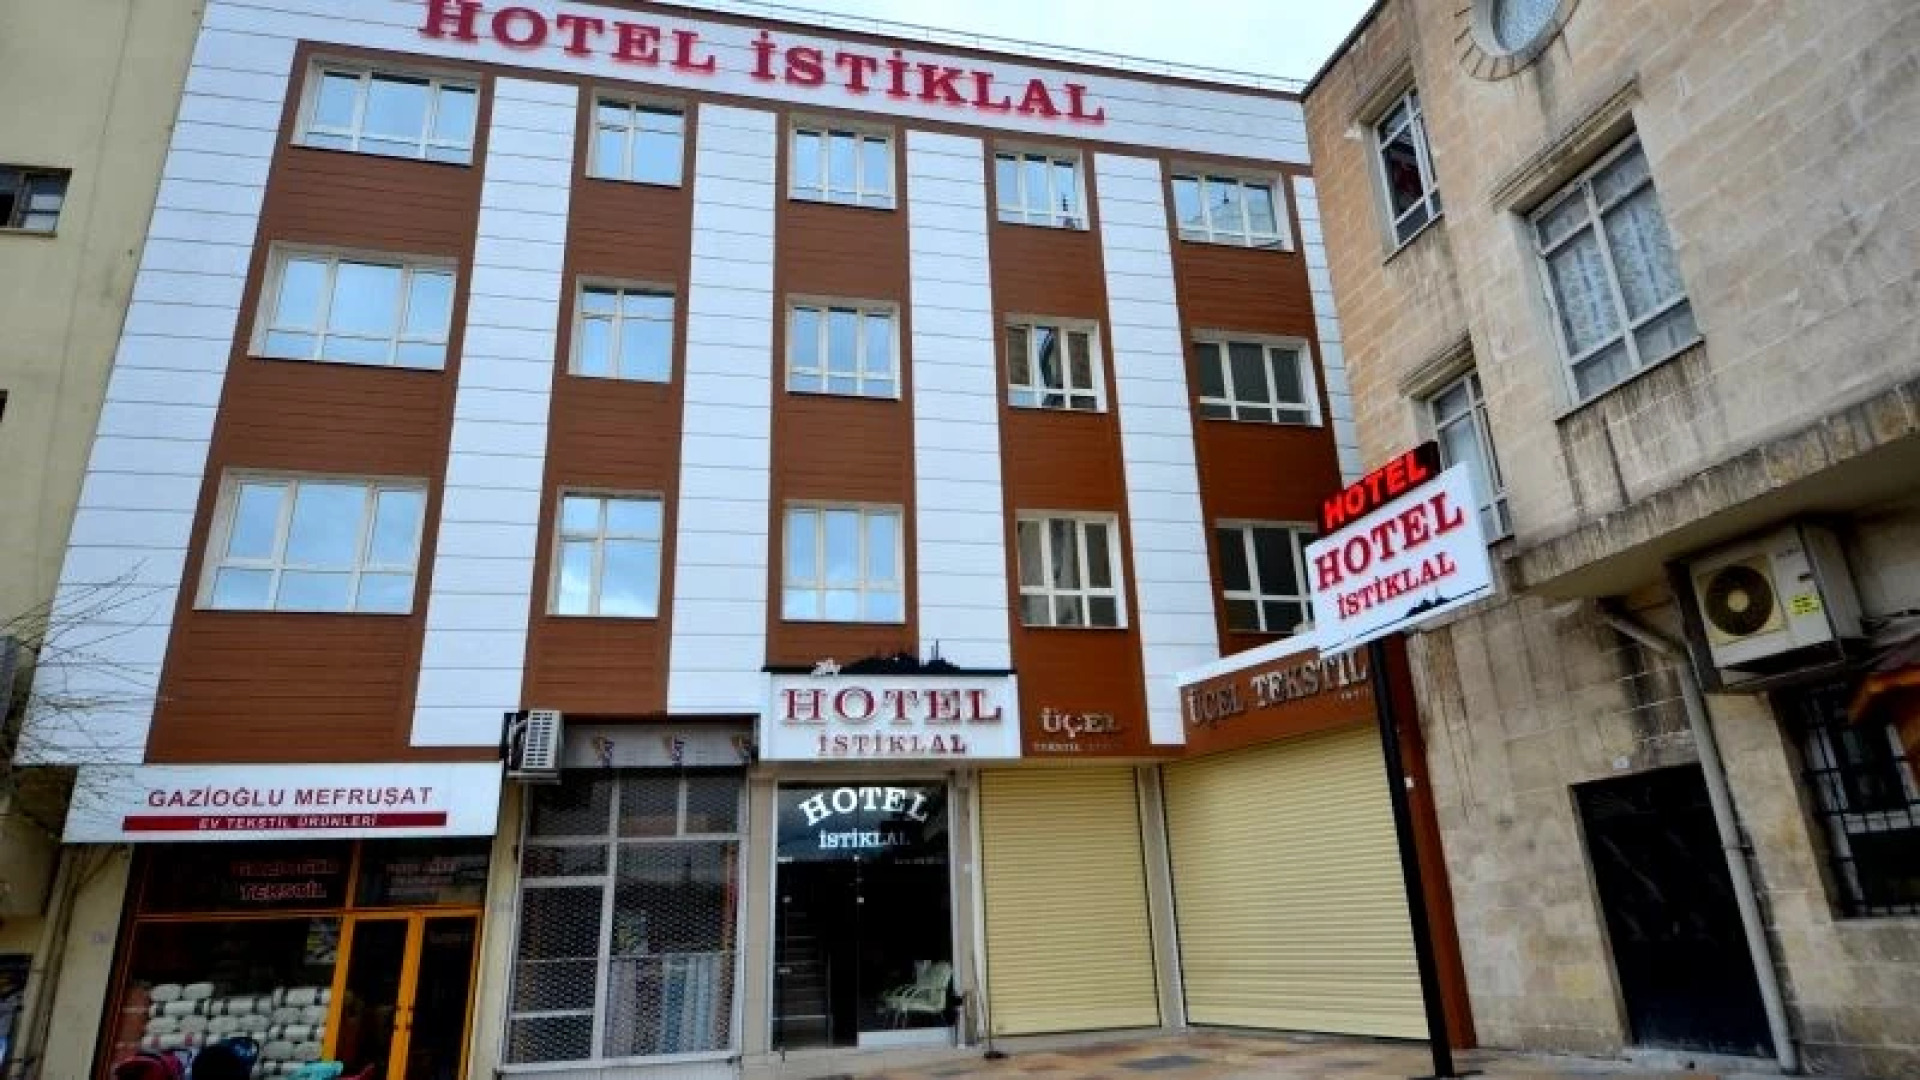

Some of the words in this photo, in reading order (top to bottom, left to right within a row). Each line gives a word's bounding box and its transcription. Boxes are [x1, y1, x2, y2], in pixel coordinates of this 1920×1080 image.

[418, 0, 716, 73] HOTEL
[750, 30, 1105, 125] İSTİKLAL
[1323, 450, 1428, 529] HOTEL
[1313, 491, 1465, 591] HOTEL
[1336, 551, 1457, 620] İSTİKLAL
[781, 686, 1003, 725] HOTEL
[1041, 707, 1120, 738] ÜÇEL
[818, 730, 968, 756] İSTİKLAL
[148, 785, 284, 808] GAZİOĞLU
[294, 786, 433, 807] MEFRUŞAT
[799, 786, 928, 826] HOTEL
[818, 827, 911, 849] İSTİKLAL
